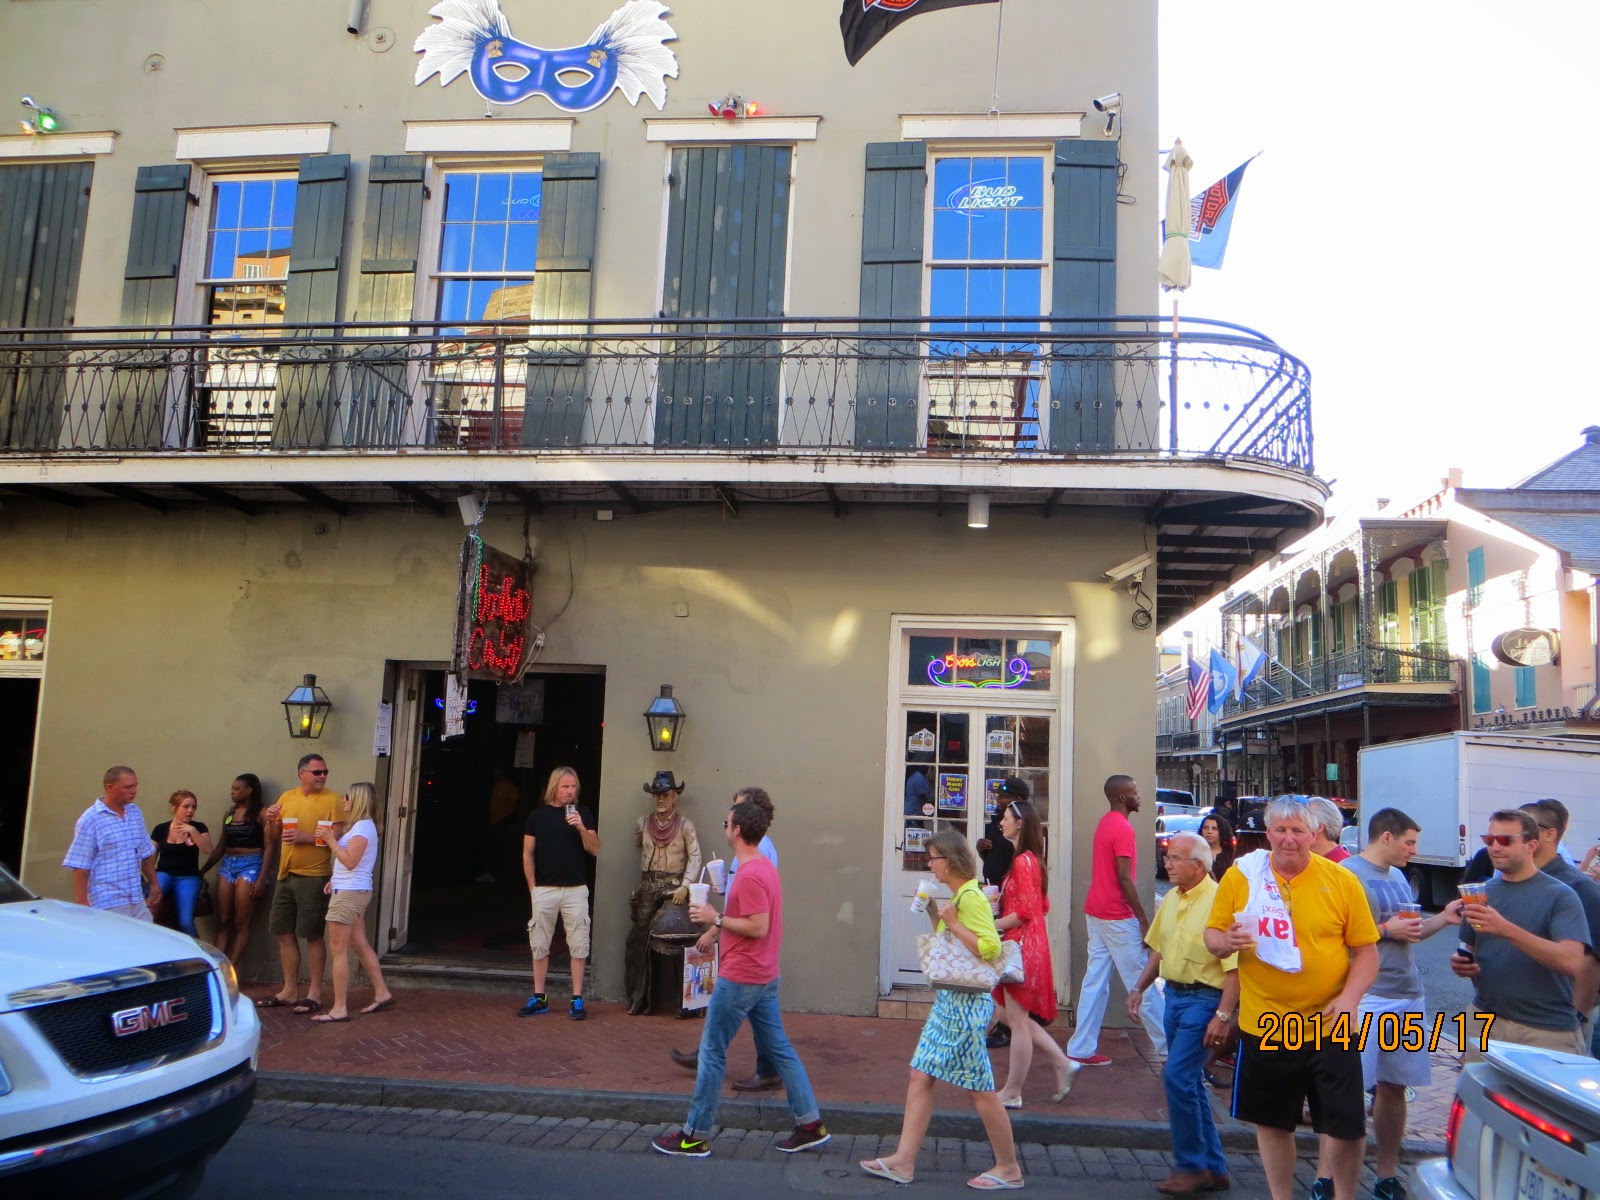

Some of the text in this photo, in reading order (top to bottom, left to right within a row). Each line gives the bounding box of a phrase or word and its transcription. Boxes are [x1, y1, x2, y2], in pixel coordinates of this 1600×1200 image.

[970, 186, 1016, 198] BUD
[958, 196, 1023, 209] LIGHT
[696, 965, 709, 977] for
[111, 998, 188, 1037] GMC
